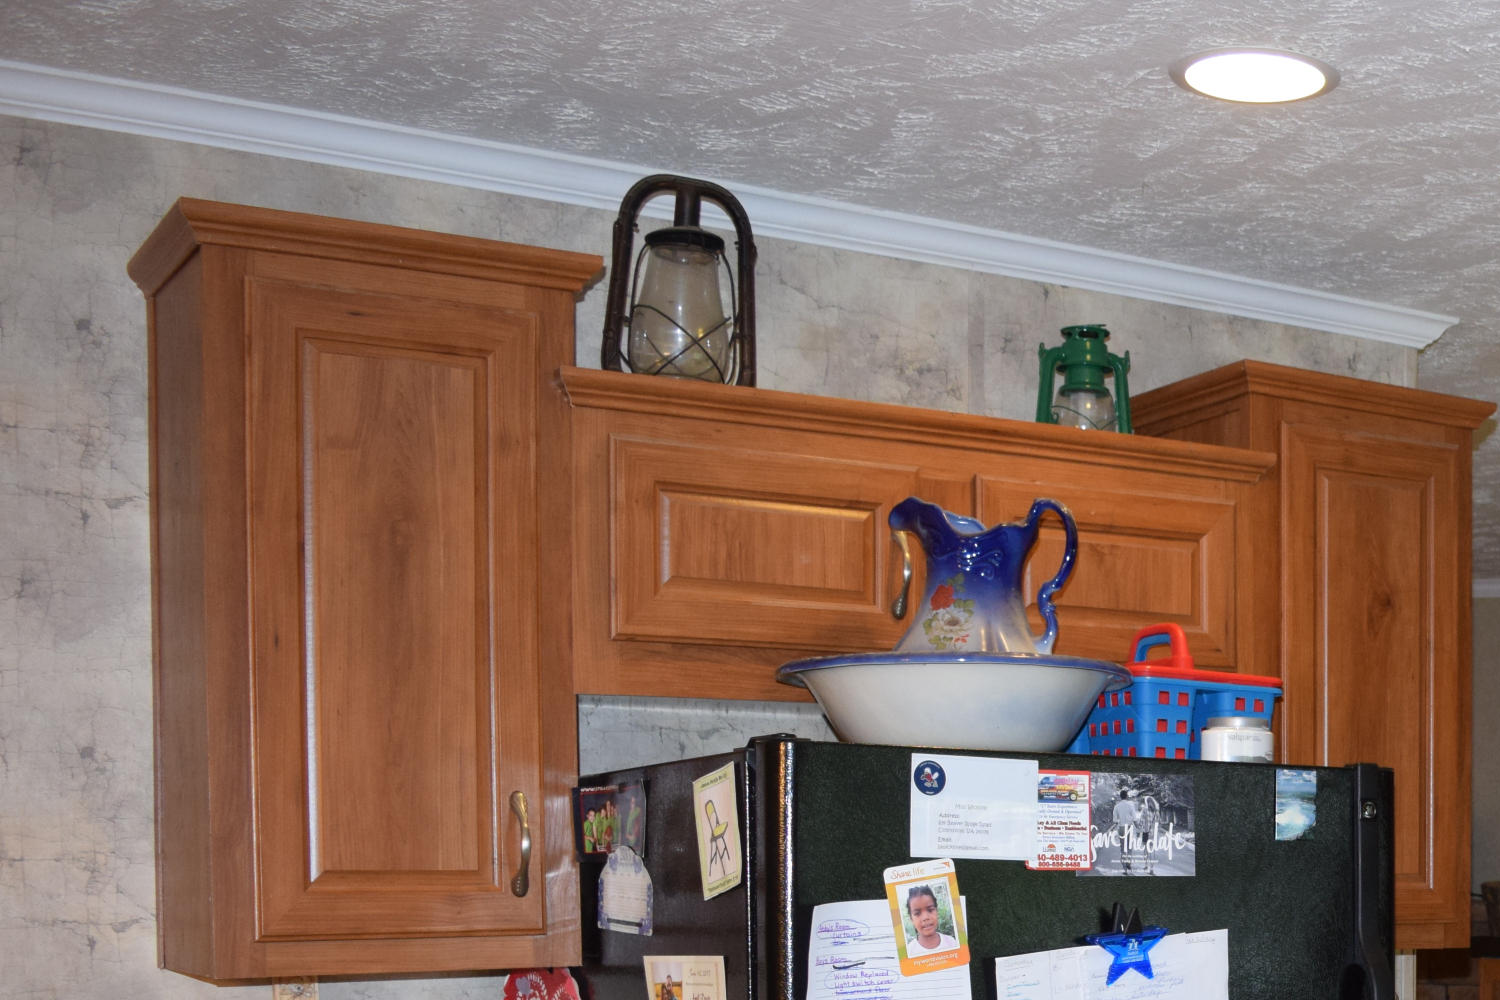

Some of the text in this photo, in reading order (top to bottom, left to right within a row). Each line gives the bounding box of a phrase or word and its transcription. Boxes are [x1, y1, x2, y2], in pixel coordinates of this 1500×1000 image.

[1090, 821, 1186, 862] Save the date
[834, 972, 858, 980] Window
